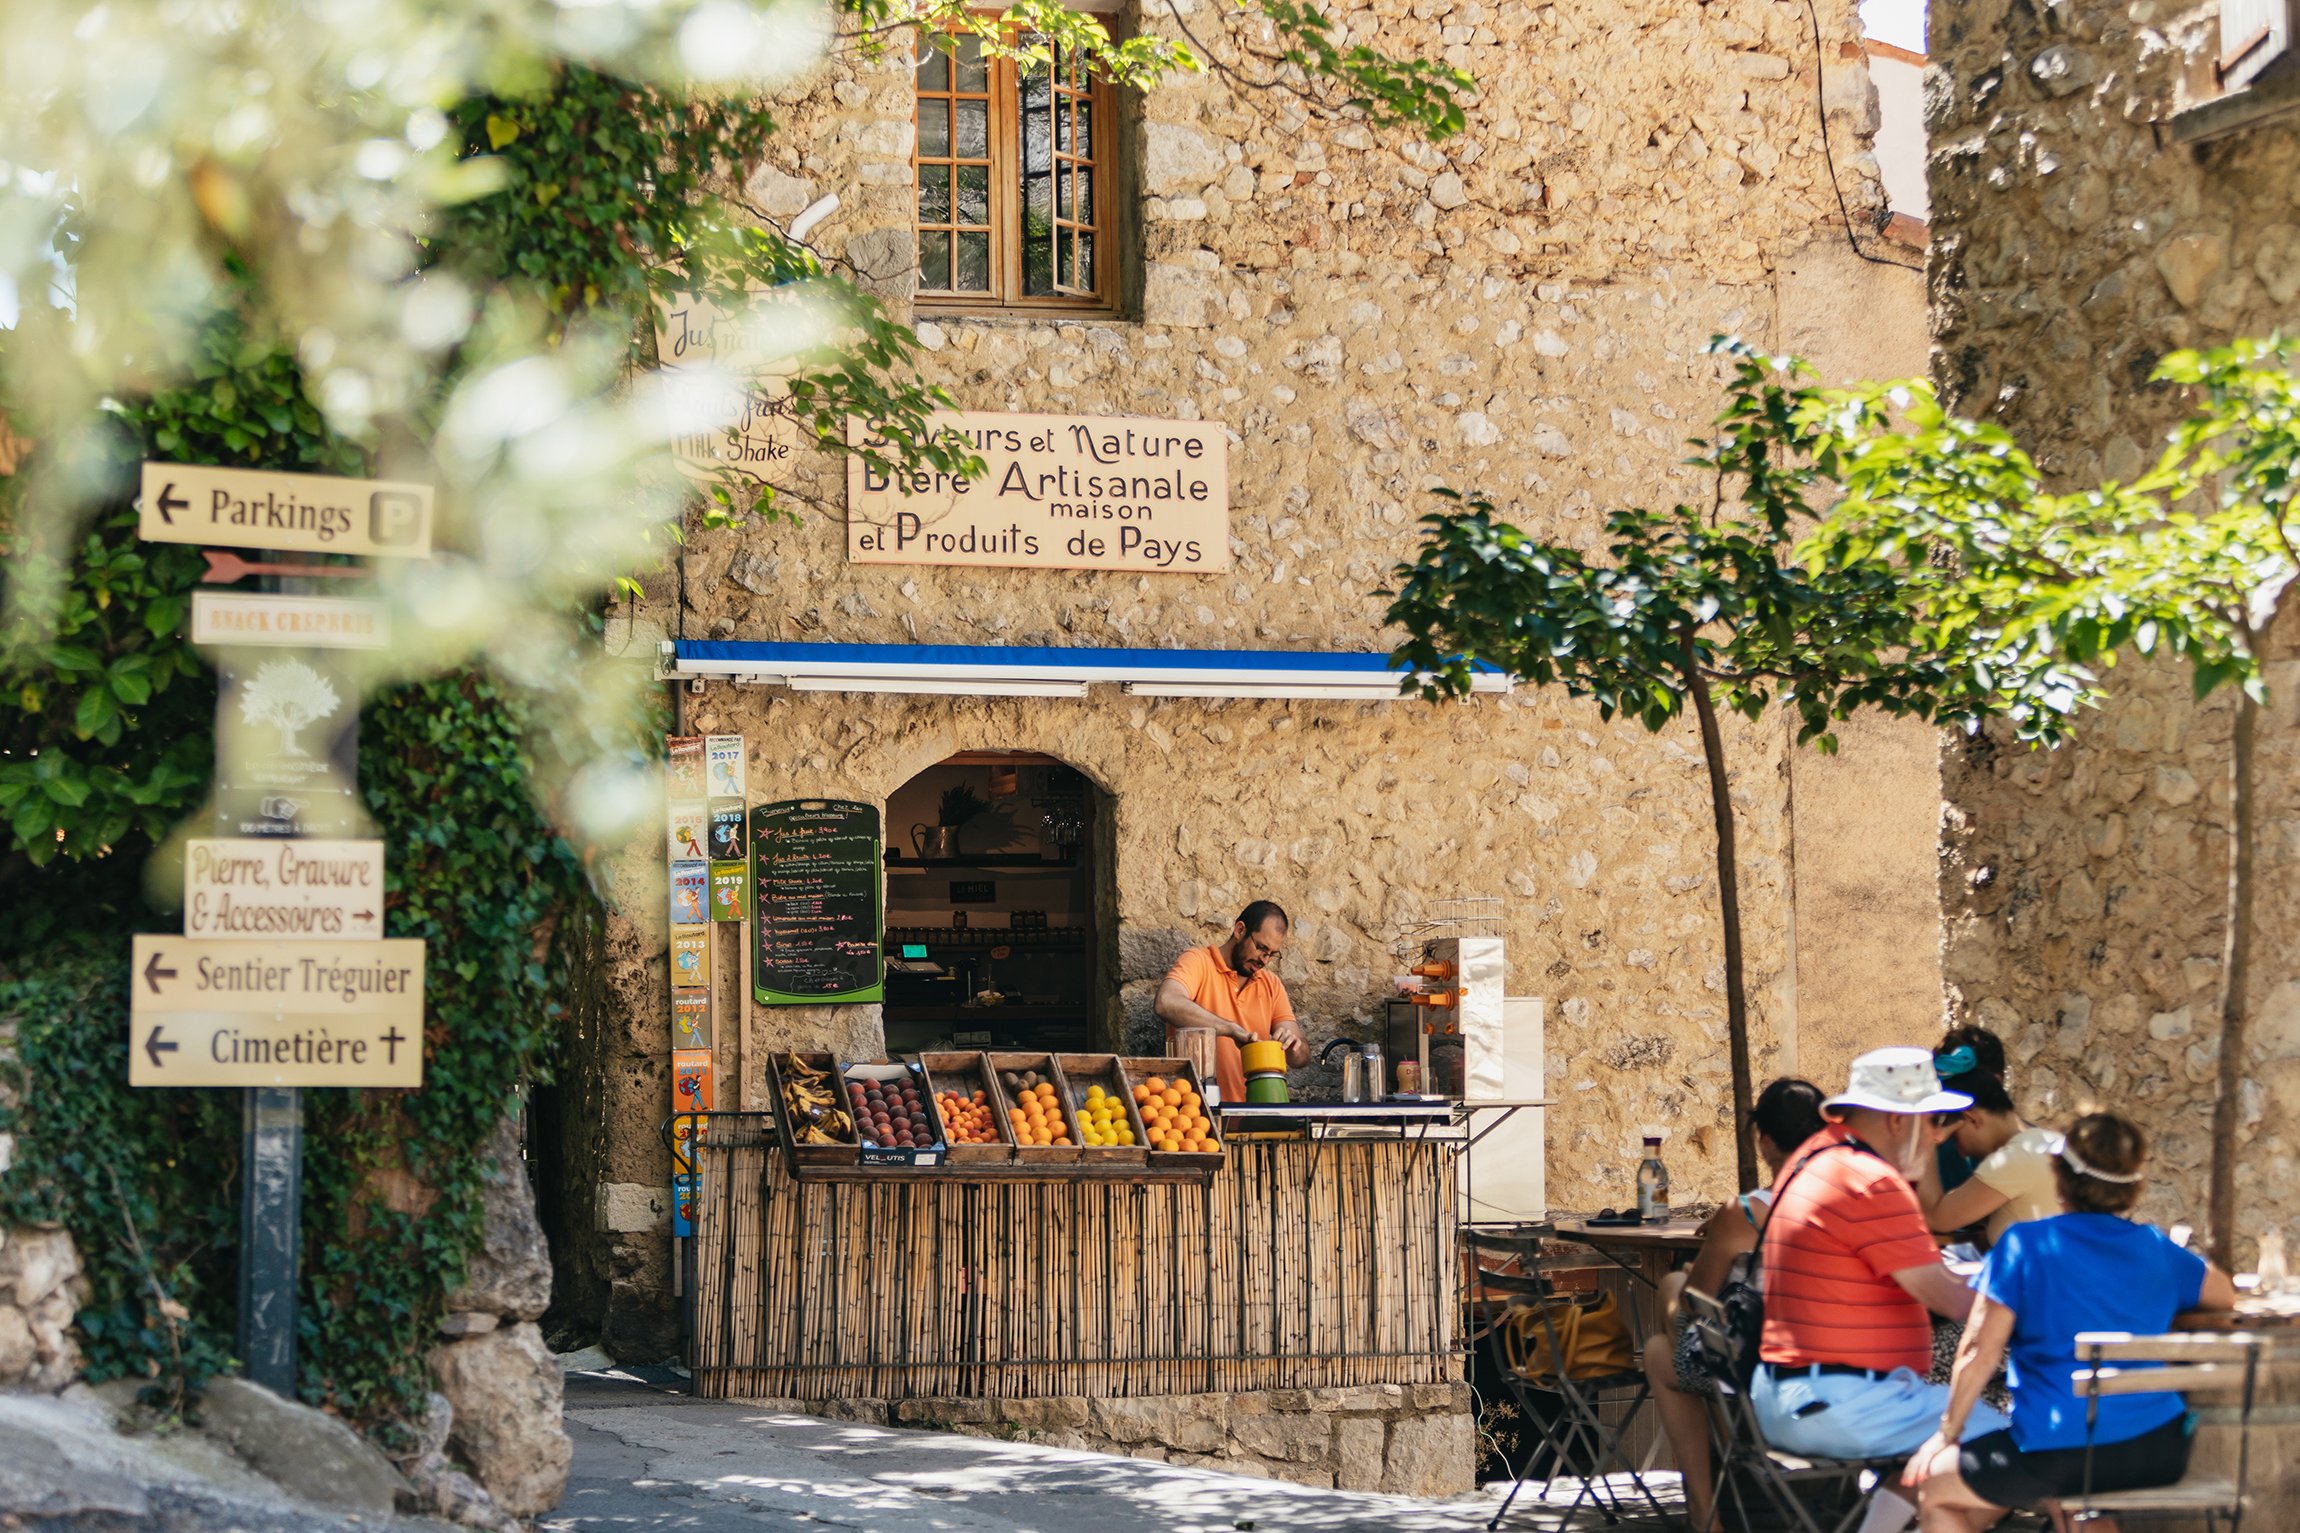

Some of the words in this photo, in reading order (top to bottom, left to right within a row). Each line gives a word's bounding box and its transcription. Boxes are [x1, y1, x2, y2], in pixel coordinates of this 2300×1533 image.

[727, 434, 789, 462] Shake
[1030, 429, 1055, 453] et
[1068, 424, 1204, 464] Nature
[998, 461, 1208, 501] Artisanale
[210, 488, 352, 542] Parkings
[377, 499, 415, 538] P
[1050, 500, 1152, 520] maison
[860, 527, 885, 551] et
[896, 512, 1039, 555] Produits
[1067, 529, 1105, 557] de
[1120, 525, 1202, 567] Pays
[711, 751, 739, 760] 2017
[713, 813, 742, 822] 2018
[192, 846, 271, 890] Pierre,
[278, 843, 370, 887] Gravure
[675, 877, 705, 886] 2014
[715, 876, 743, 885] 2019
[192, 892, 208, 932] &
[213, 893, 344, 934] Accessoires
[676, 941, 705, 949] 2013
[196, 957, 291, 993] Sentier
[300, 957, 411, 1004] Tréguier
[676, 997, 707, 1005] routard
[677, 1005, 706, 1013] 2012
[210, 1028, 367, 1064] Cimetière
[679, 1067, 707, 1075] 2011
[677, 1122, 708, 1130] rouard
